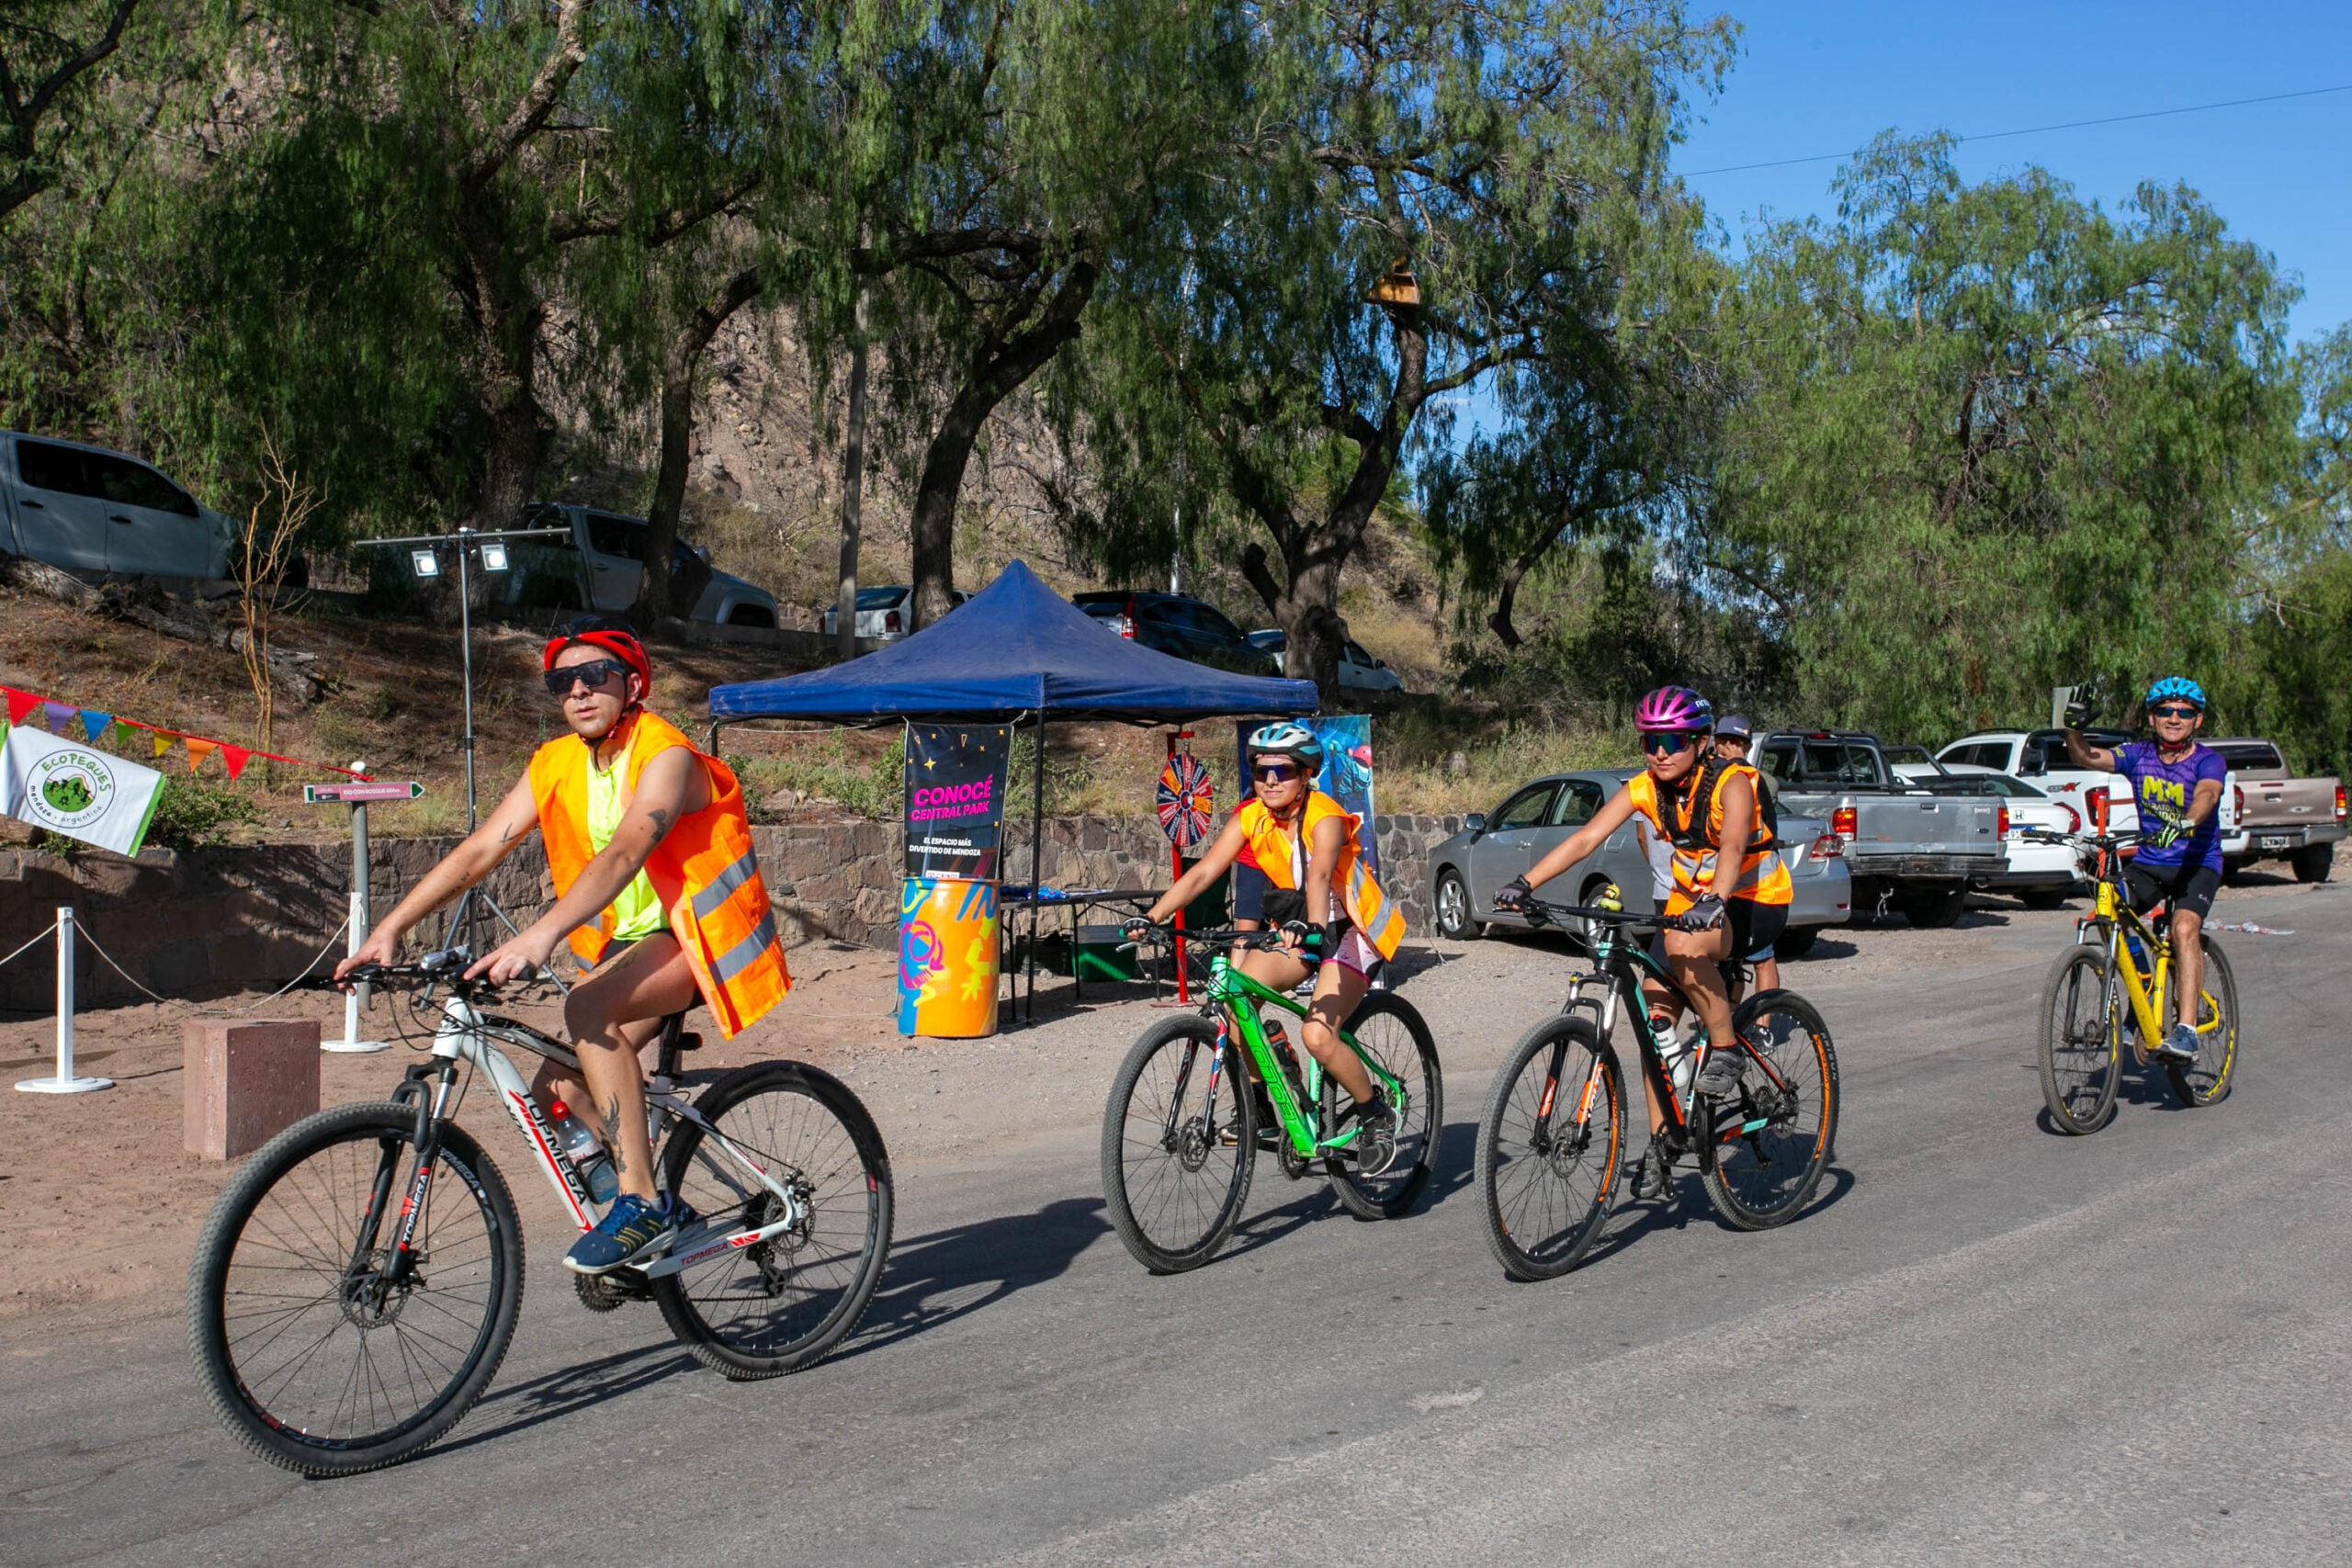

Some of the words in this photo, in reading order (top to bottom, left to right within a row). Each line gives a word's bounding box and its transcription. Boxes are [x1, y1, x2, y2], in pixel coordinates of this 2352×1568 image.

[41, 753, 112, 792] ECOPEQUES
[30, 785, 51, 817] mendoza
[913, 773, 993, 807] CONOCÉ
[61, 806, 103, 825] argentina
[910, 806, 961, 821] CENTRAL
[963, 801, 989, 816] PARK
[909, 845, 943, 854] DIVERTIDO
[944, 847, 952, 855] DE
[952, 847, 981, 856] MENDOZA
[958, 838, 971, 846] MÁS
[522, 1091, 587, 1206] TOPMEGA
[402, 1175, 428, 1242] TOPMEGA
[681, 1242, 728, 1266] TOPMEGA
